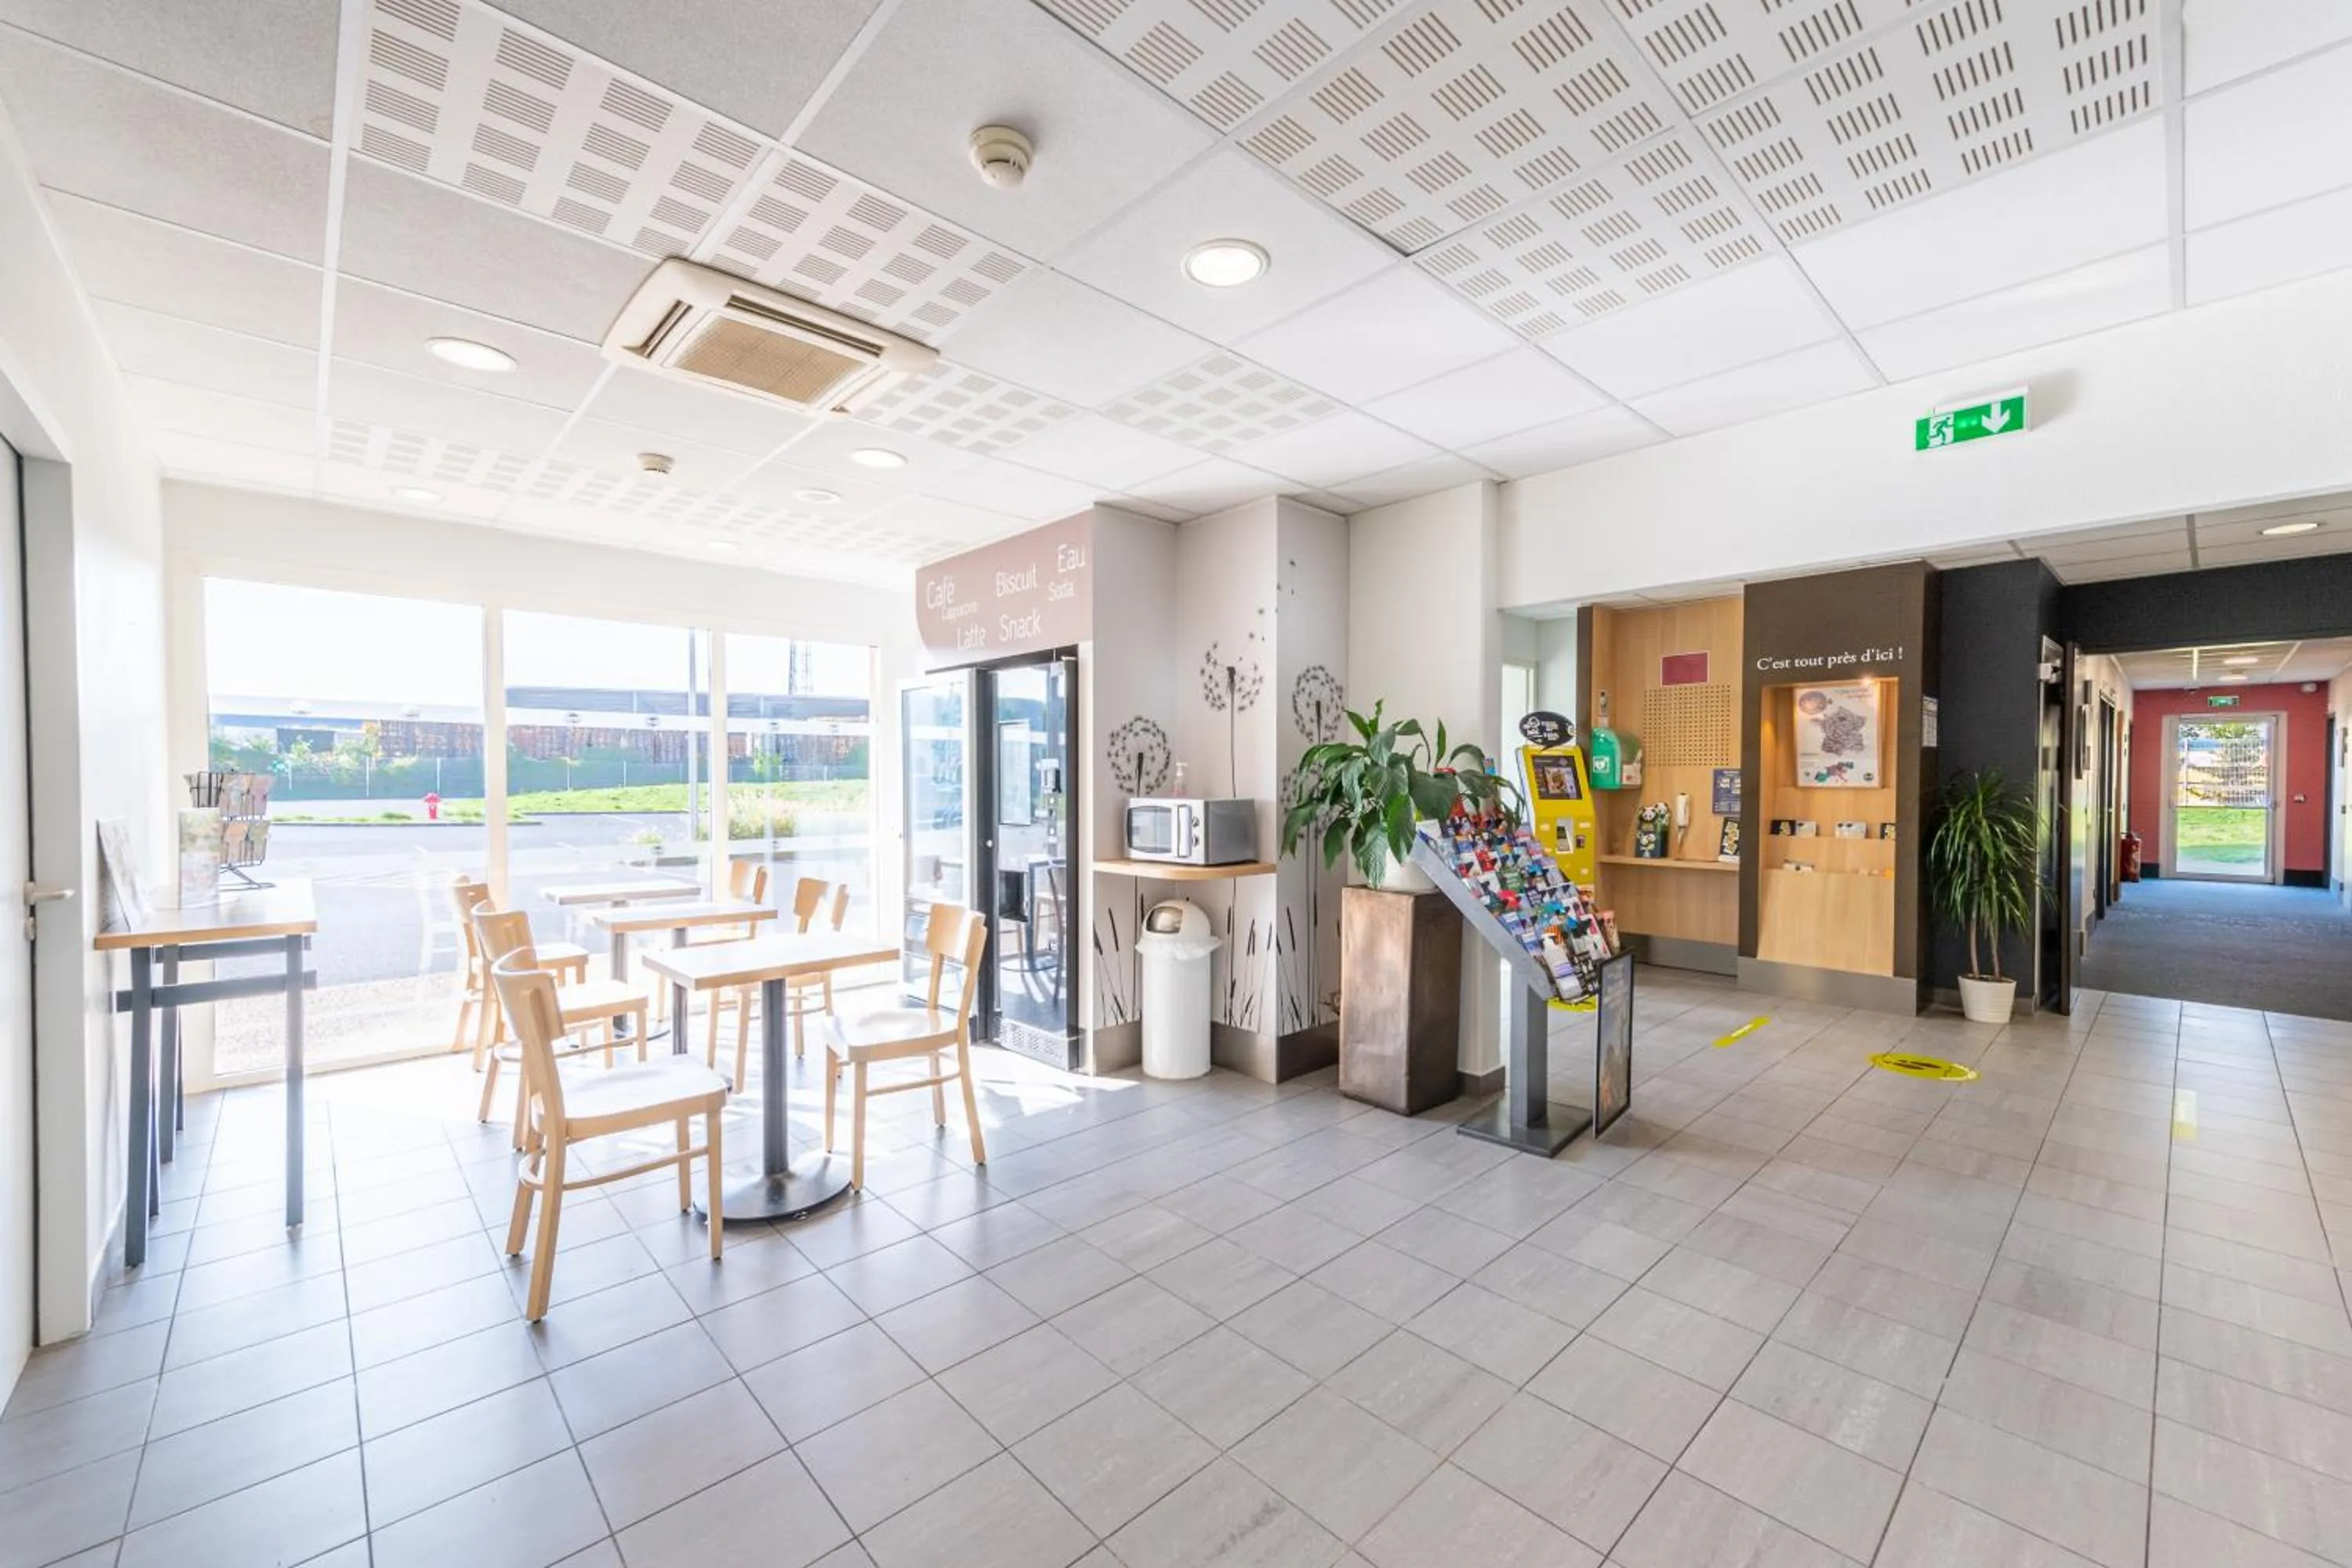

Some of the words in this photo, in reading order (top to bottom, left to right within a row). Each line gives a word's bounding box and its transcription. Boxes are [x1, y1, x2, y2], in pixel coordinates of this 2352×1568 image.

[1057, 543, 1085, 572] Eau
[926, 575, 955, 610] Café
[996, 563, 1038, 597] Biscuit
[956, 622, 987, 652] Latte
[999, 608, 1042, 641] Snack
[1756, 656, 1791, 671] C'est
[1794, 655, 1824, 668] tout
[1827, 651, 1857, 670] près
[1860, 648, 1894, 663] d'ici
[1896, 645, 1904, 660] !
